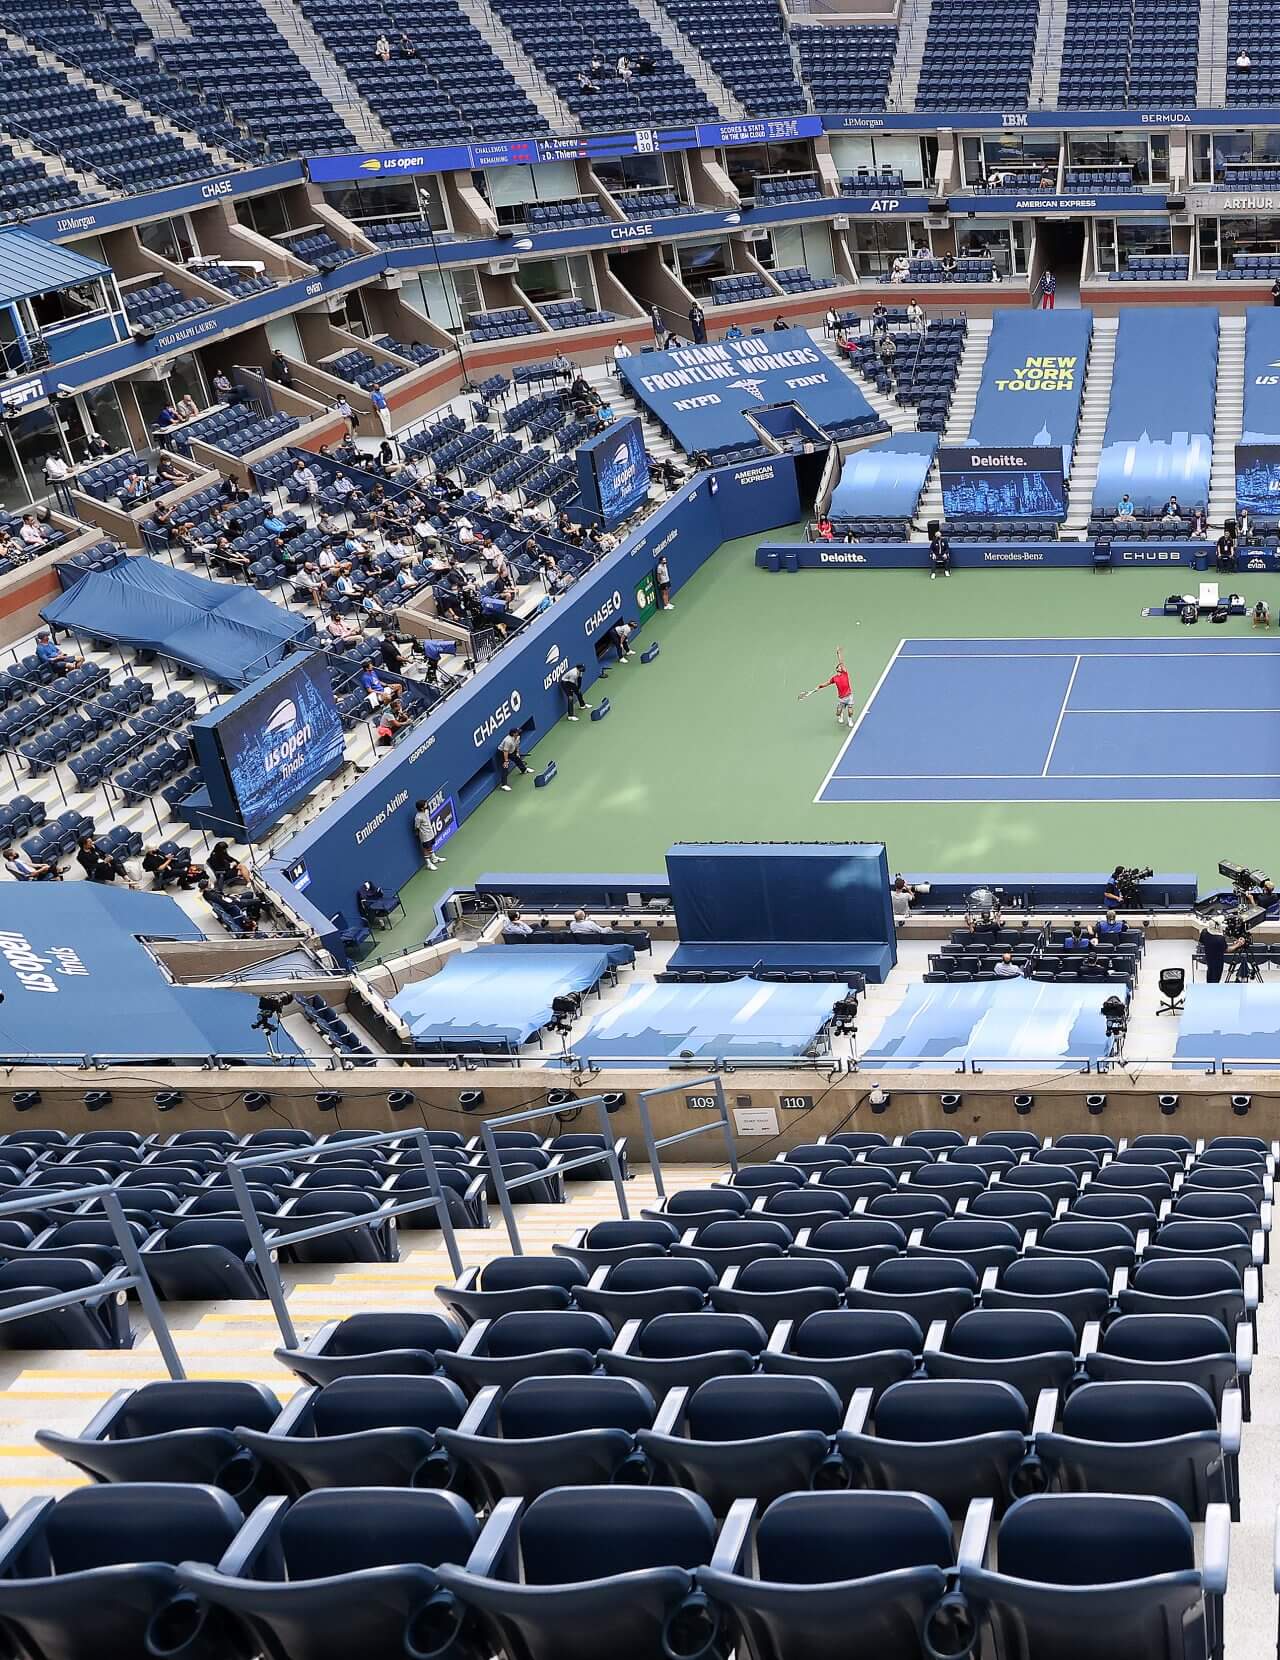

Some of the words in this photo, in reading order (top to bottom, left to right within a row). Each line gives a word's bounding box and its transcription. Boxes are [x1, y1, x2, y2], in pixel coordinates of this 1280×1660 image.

[843, 117, 883, 128] J.P.Morgan
[1001, 114, 1028, 126] IBM
[1141, 114, 1191, 122] BERMUDA
[639, 132, 650, 141] 30
[653, 130, 658, 140] 4
[720, 126, 740, 135] SCORES
[748, 124, 765, 132] STATS
[768, 120, 799, 138] IBM
[554, 138, 578, 149] Zverev
[640, 142, 651, 152] 30
[654, 142, 660, 150] 2
[384, 158, 397, 169] us
[398, 154, 424, 170] open
[558, 150, 578, 160] Thiem
[201, 180, 232, 198] CHASE
[870, 200, 899, 212] ATP
[1016, 200, 1058, 209] AMERICAN
[1060, 200, 1097, 208] EXPRESS
[1224, 197, 1274, 209] ARTHUR
[57, 215, 96, 232] J.P.Morgan
[610, 225, 654, 239] CHASE
[305, 282, 323, 296] evian
[158, 331, 175, 348] POLO
[176, 326, 194, 344] RALPH
[194, 320, 218, 338] LAUREN
[668, 345, 726, 368] THANK
[729, 338, 769, 357] YOU
[1025, 356, 1077, 368] NEW
[640, 362, 740, 393] FRONTLINE
[739, 348, 820, 374] WORKERS
[1013, 368, 1075, 380] YORK
[784, 373, 829, 389] FDNY
[995, 380, 1074, 392] TOUGH
[1255, 376, 1278, 385] us
[0, 379, 44, 405] ESPN
[672, 393, 722, 412] NYPD
[971, 455, 1028, 467] Deloitte.
[612, 474, 622, 490] us
[620, 464, 636, 485] open
[734, 465, 773, 480] AMERICAN
[740, 471, 775, 486] EXPRESS
[820, 553, 867, 563] Deloitte.
[984, 552, 1044, 562] Mercedes-Benz
[1123, 552, 1180, 560] CHUBB
[584, 599, 614, 637] CHASE
[543, 675, 554, 690] us
[552, 656, 569, 683] open
[473, 700, 512, 748] CHASE
[264, 751, 281, 772] us
[280, 723, 312, 762] open
[281, 752, 305, 780] finals
[428, 790, 446, 814] IBM
[355, 810, 386, 845] Emirates
[386, 789, 409, 818] Airline
[294, 864, 302, 878] 14
[44, 947, 90, 976] finals
[690, 1098, 714, 1108] 109
[783, 1098, 805, 1108] 110
